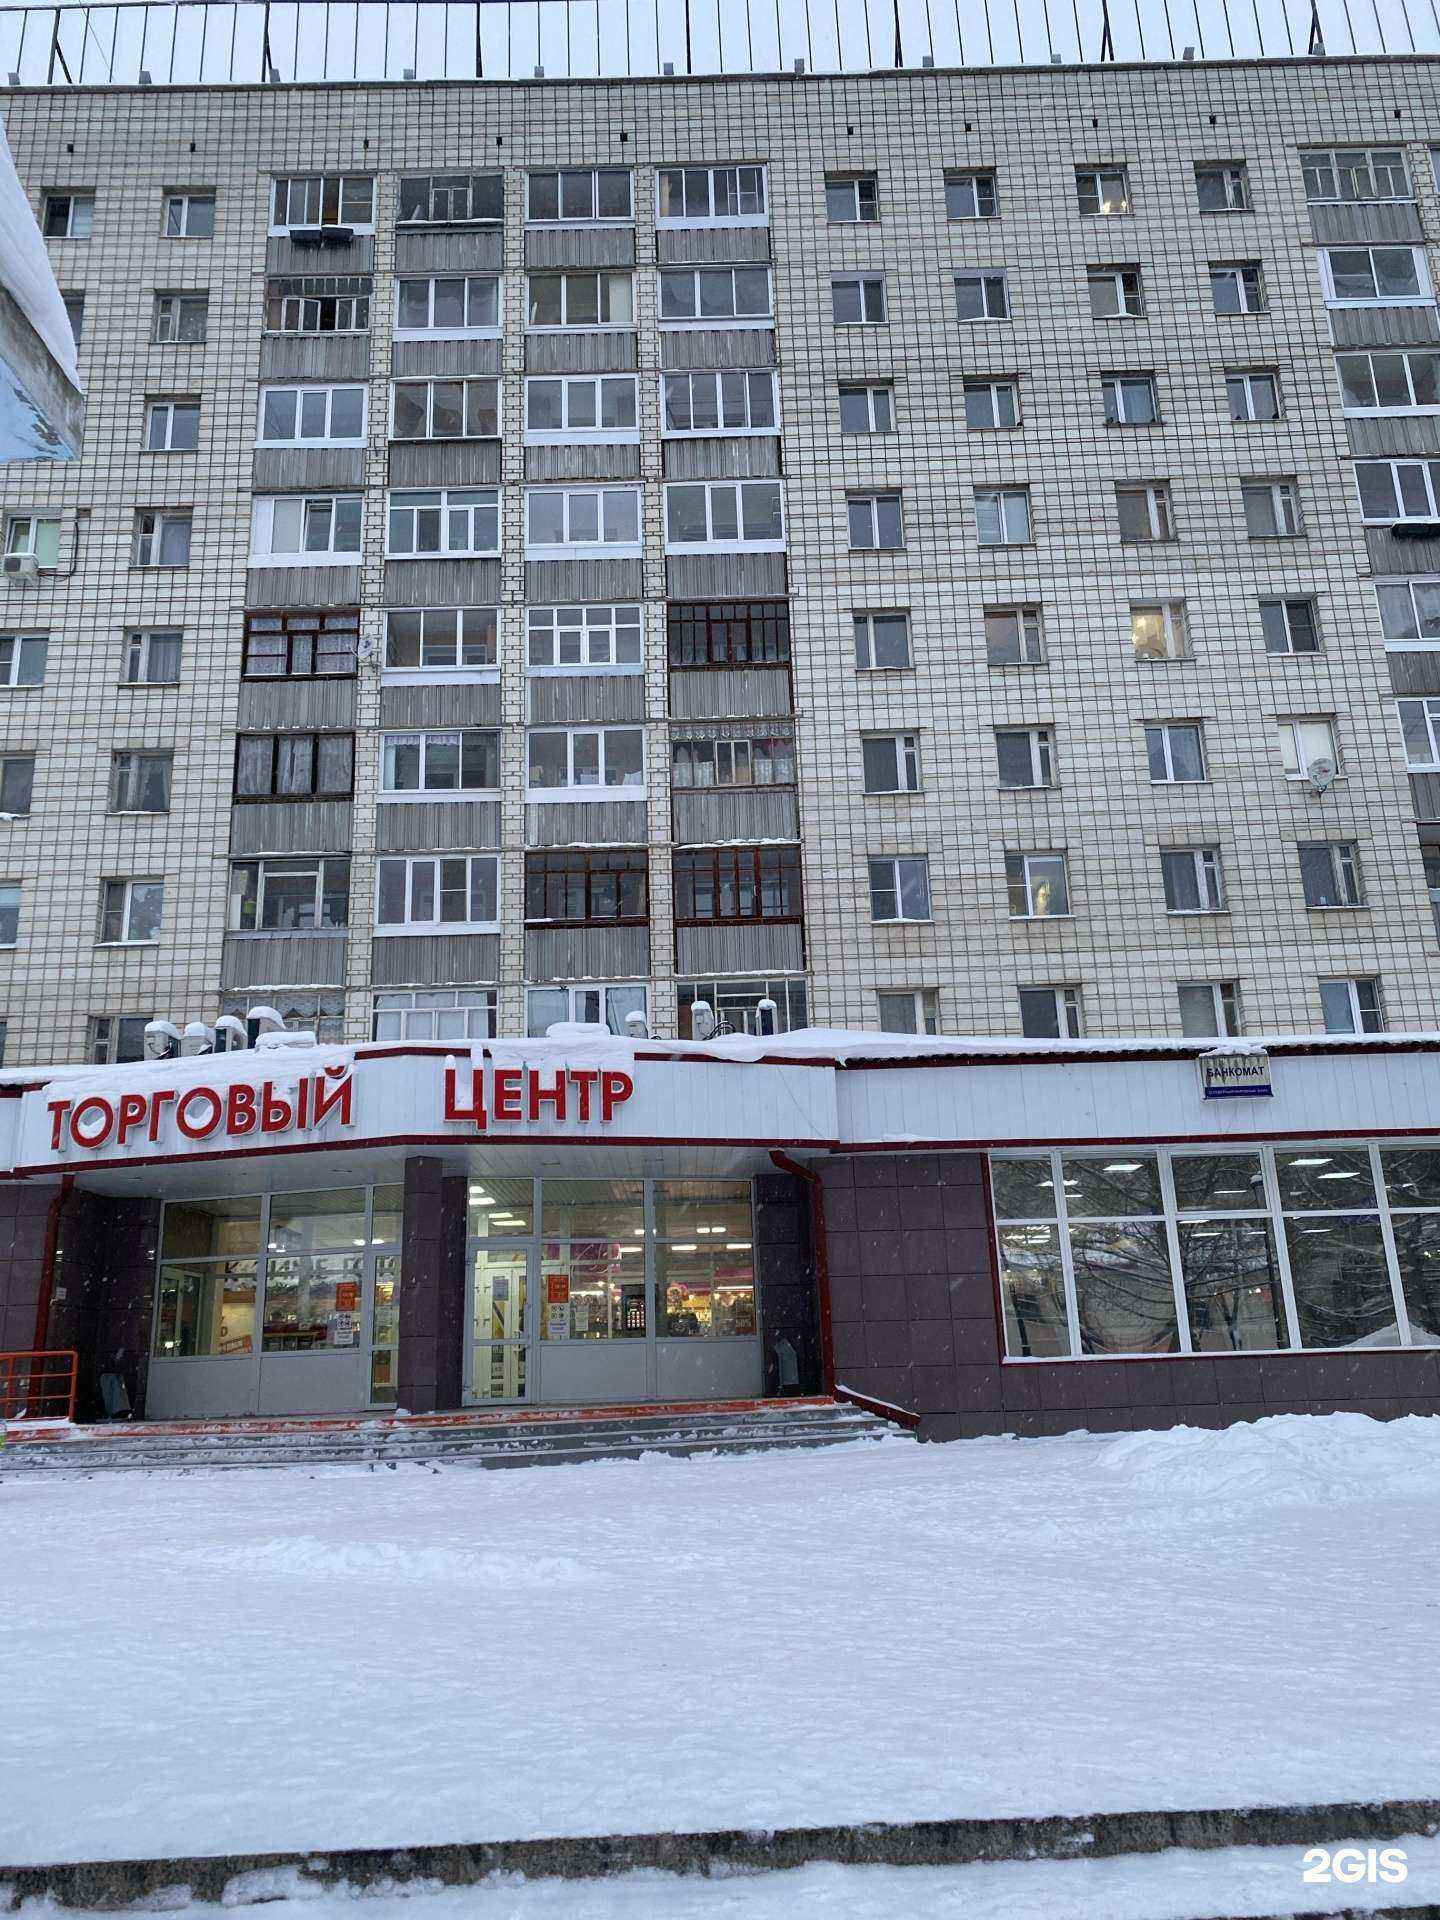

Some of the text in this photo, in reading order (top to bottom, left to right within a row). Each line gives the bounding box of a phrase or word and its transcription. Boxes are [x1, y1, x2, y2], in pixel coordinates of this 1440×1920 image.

[1206, 1066, 1265, 1078] БАНКОМАТ
[47, 1065, 634, 1150] ТОРГОВЫЙ ЦЕНТР
